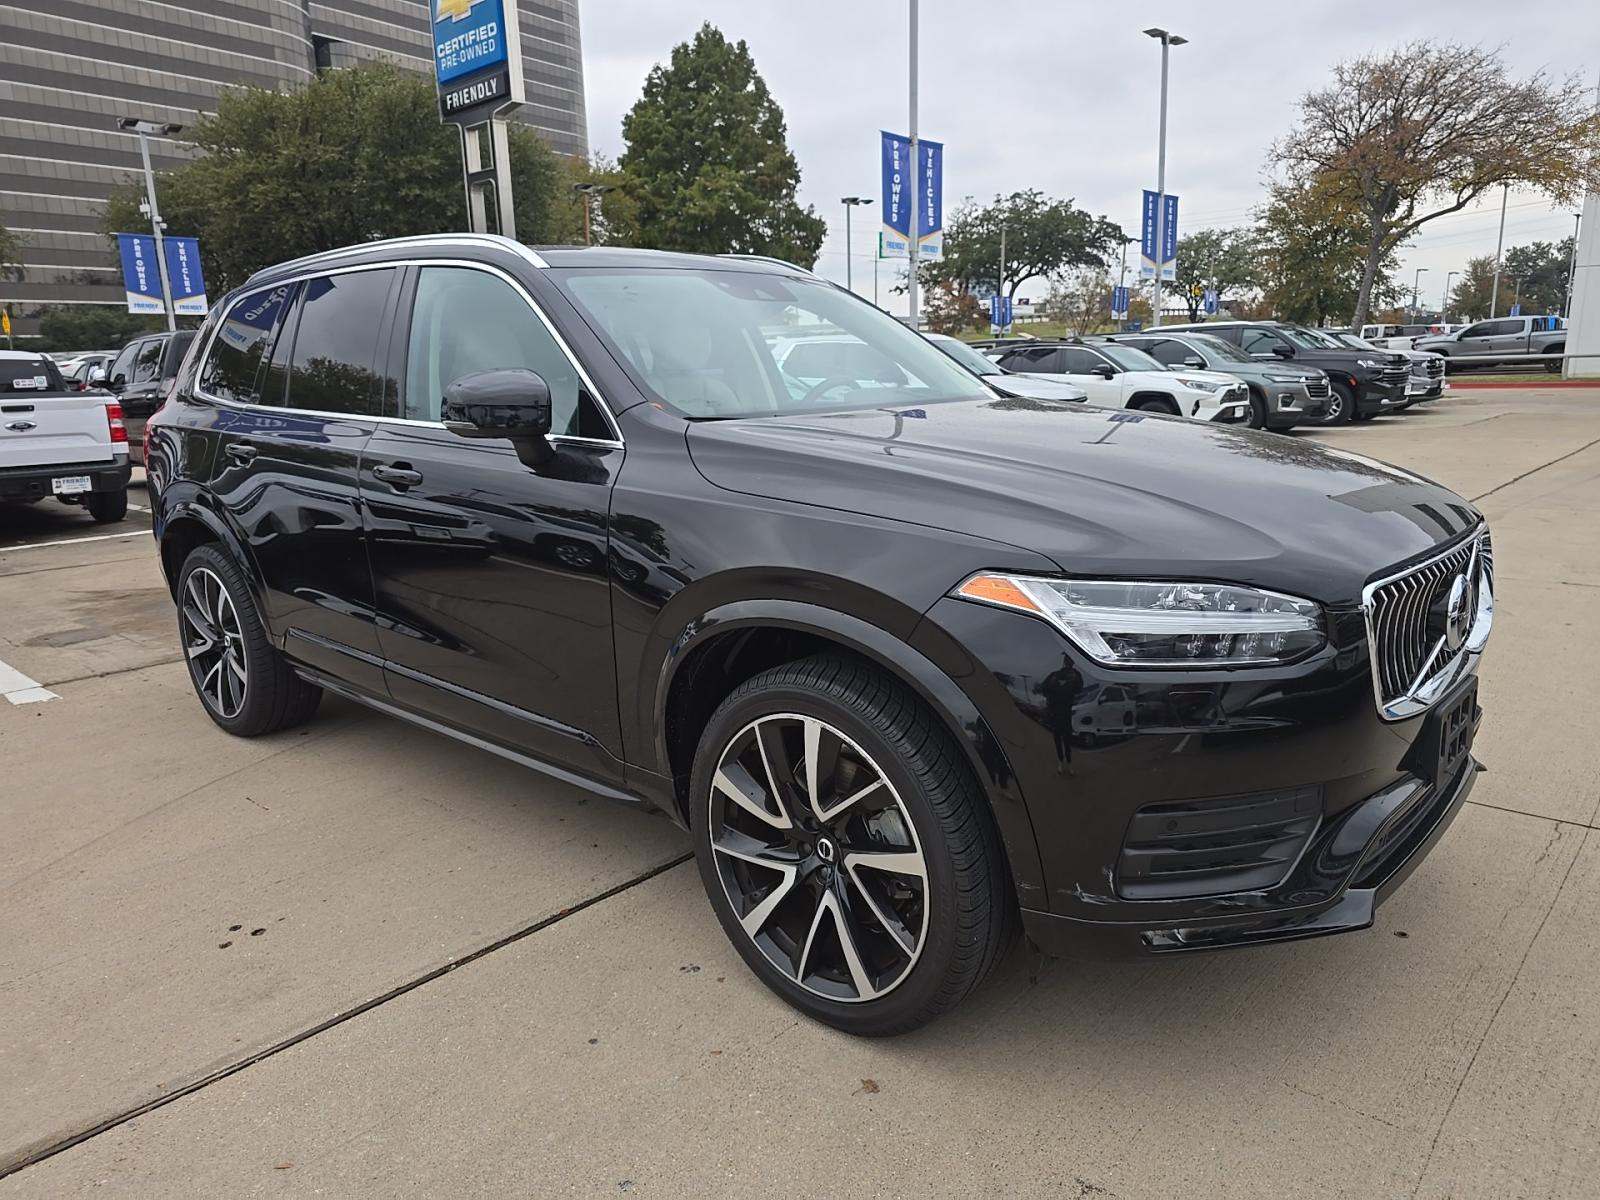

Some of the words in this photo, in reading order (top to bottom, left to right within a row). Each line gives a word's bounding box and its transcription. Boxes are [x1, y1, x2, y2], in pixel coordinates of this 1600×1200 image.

[436, 22, 497, 58] CERTIFIED
[441, 39, 496, 71] PRE-OWNED
[446, 77, 497, 110] FRIENDLY
[892, 140, 900, 170] PRE
[892, 174, 901, 223] OWNED
[926, 147, 935, 227] VEHICLES
[133, 238, 142, 258] PRE
[135, 259, 148, 292] OWNED
[177, 241, 192, 294] VEHICLES
